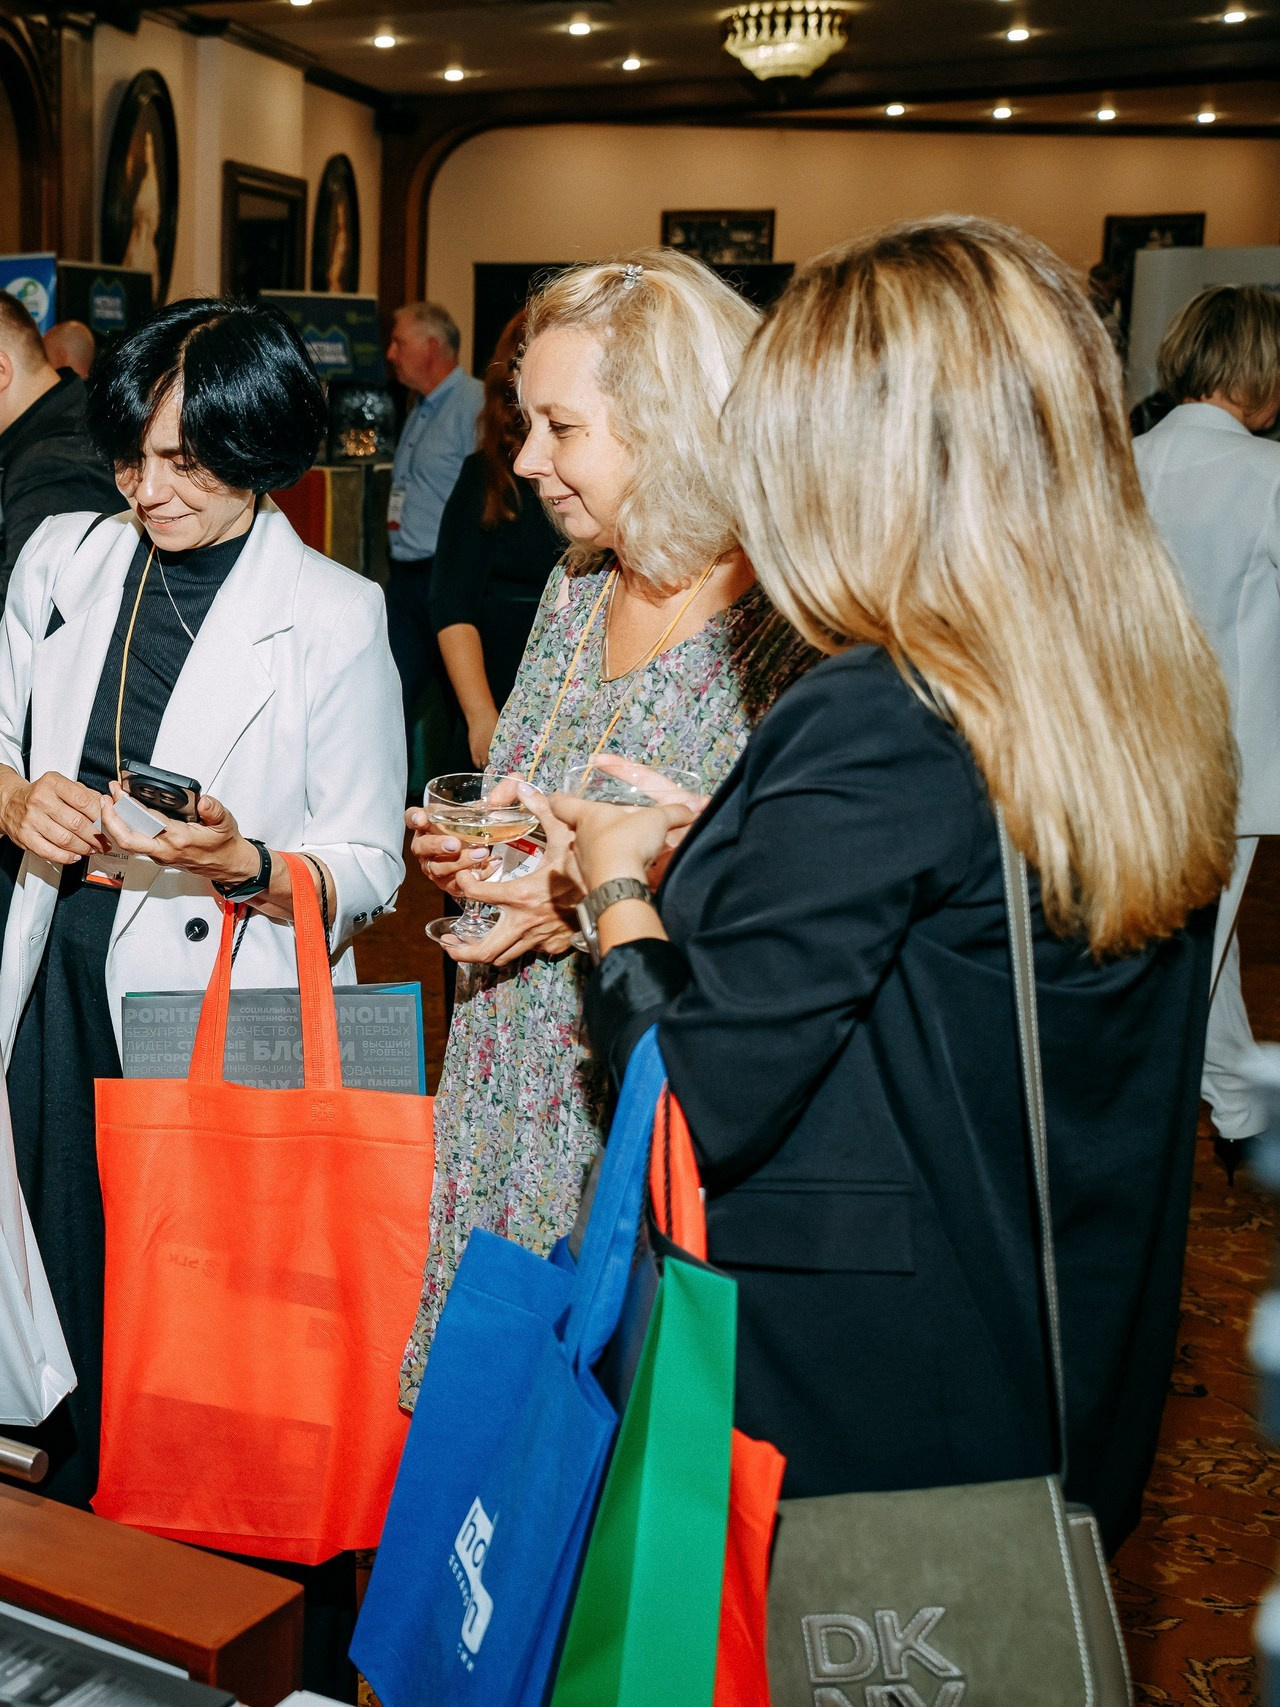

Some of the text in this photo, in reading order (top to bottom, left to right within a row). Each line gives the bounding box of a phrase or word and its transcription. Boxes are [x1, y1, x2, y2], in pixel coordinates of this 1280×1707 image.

[124, 1007, 200, 1023] PORITE
[335, 1007, 409, 1023] NOLIT
[124, 1026, 297, 1038] БЕЗУПРЕЧ КАЧЕСТВО
[355, 1026, 411, 1036] ПЕРВЫХ
[126, 1041, 172, 1052] ЛИДЕР
[362, 1039, 411, 1048] ВЫСШИЙ
[362, 1049, 411, 1057] УРОВЕНЬ
[125, 1065, 188, 1075] ПРОГРЕССИ
[368, 1079, 412, 1087] ПАНЕЛИ
[801, 1607, 963, 1684] DK
